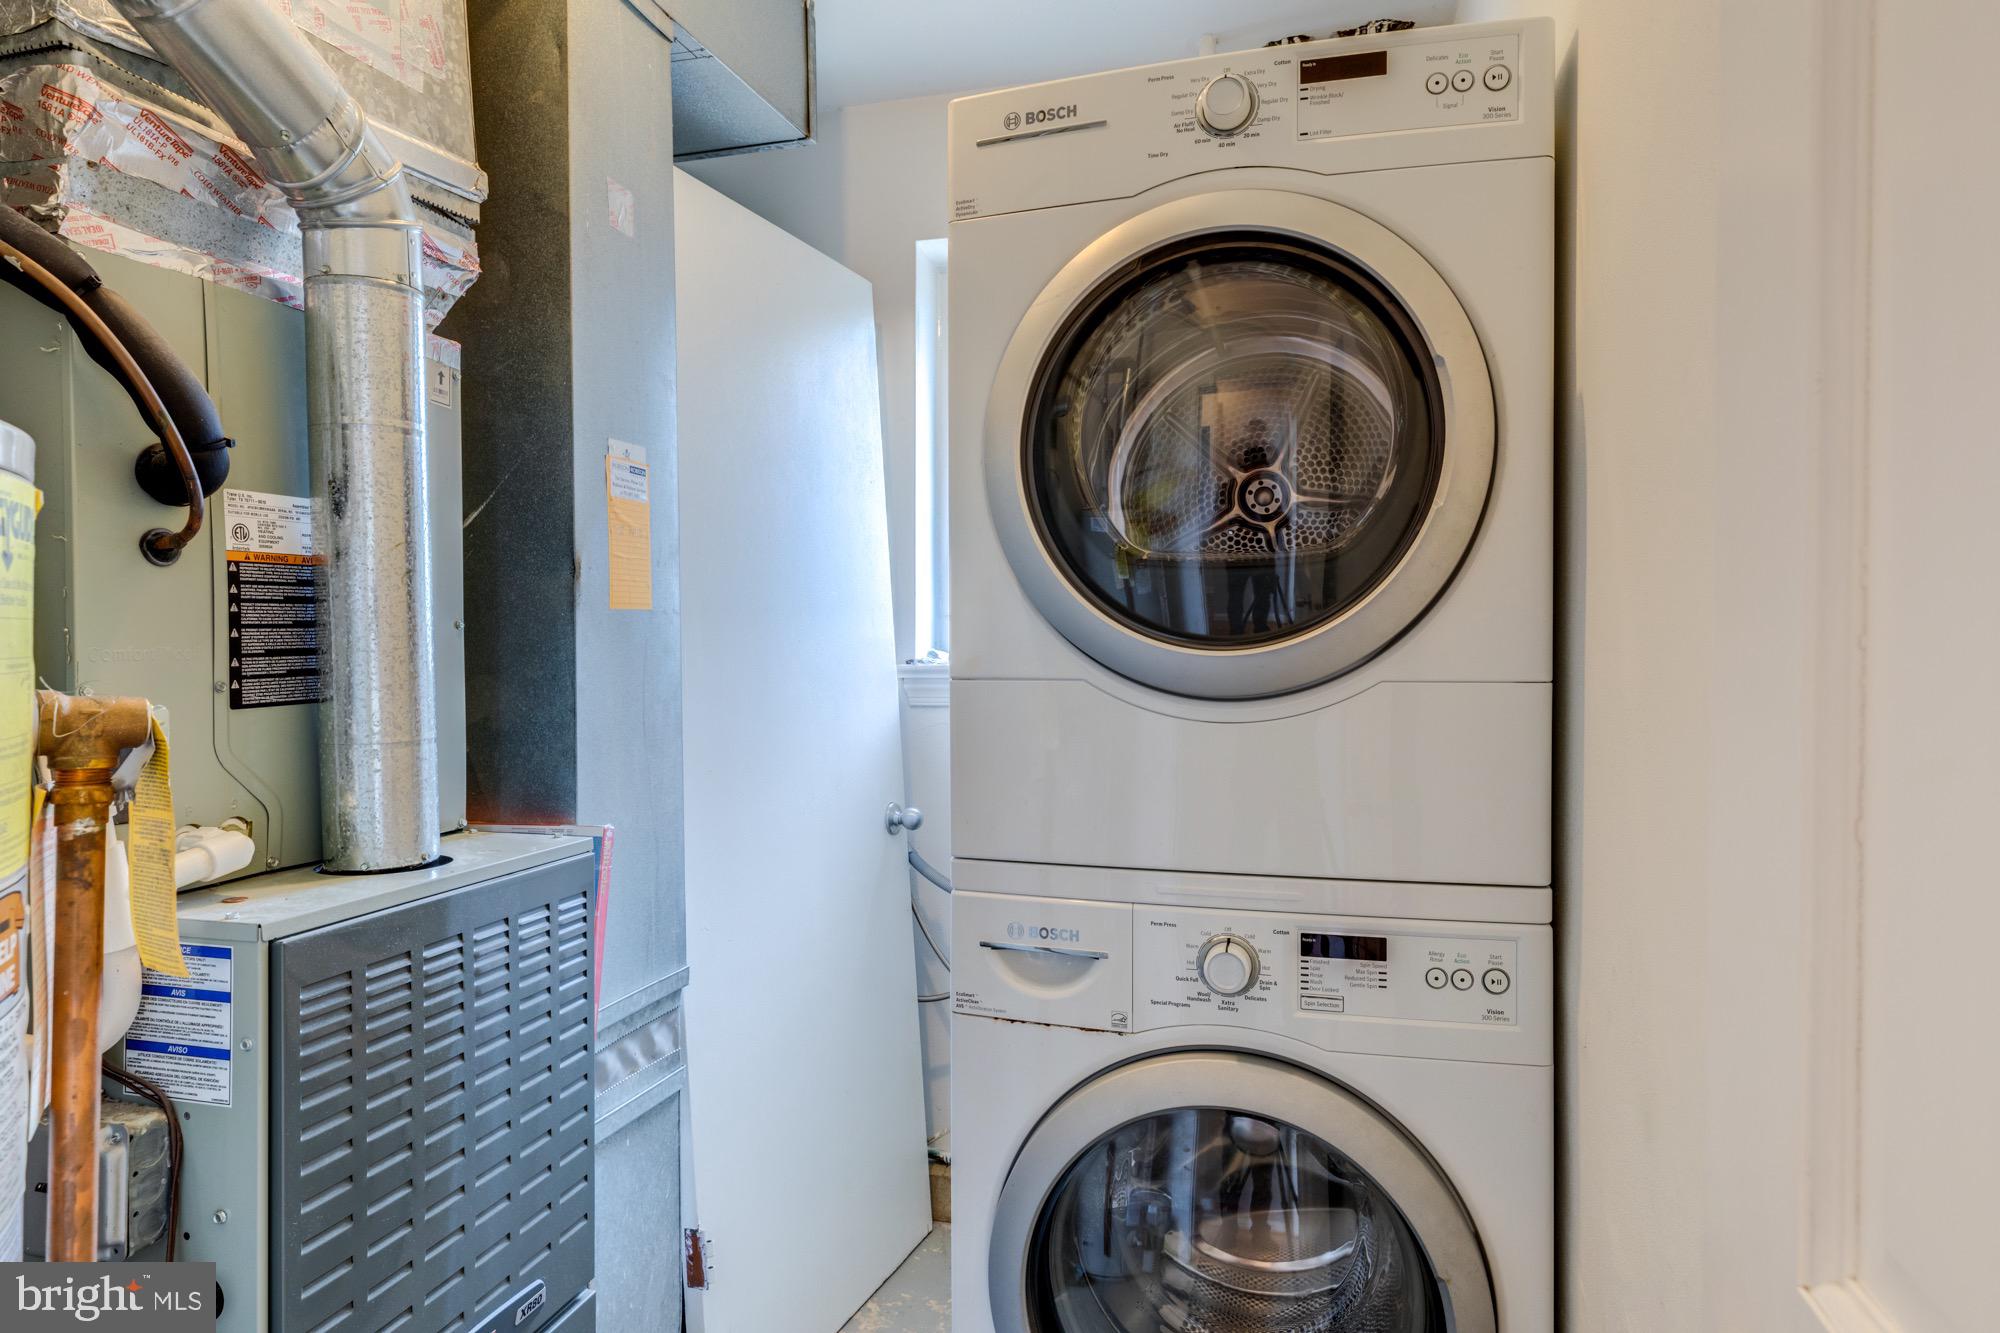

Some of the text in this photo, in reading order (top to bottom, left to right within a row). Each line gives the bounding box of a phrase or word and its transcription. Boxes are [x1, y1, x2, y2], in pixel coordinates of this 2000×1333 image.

[1455, 57, 1472, 65] Action
[1443, 102, 1458, 110] Signal
[1025, 104, 1077, 125] BOSCH
[1494, 111, 1512, 119] Series
[139, 109, 193, 160] VentureTape
[219, 144, 264, 190] VentureTape
[193, 170, 243, 217] COLD WEATHER
[253, 553, 289, 563] WARNING
[1029, 926, 1080, 943] BOSCH
[171, 989, 186, 997] AVIS
[1168, 1001, 1191, 1009] Programs
[1217, 1005, 1239, 1013] Sanitary
[167, 1046, 188, 1054] AVISO
